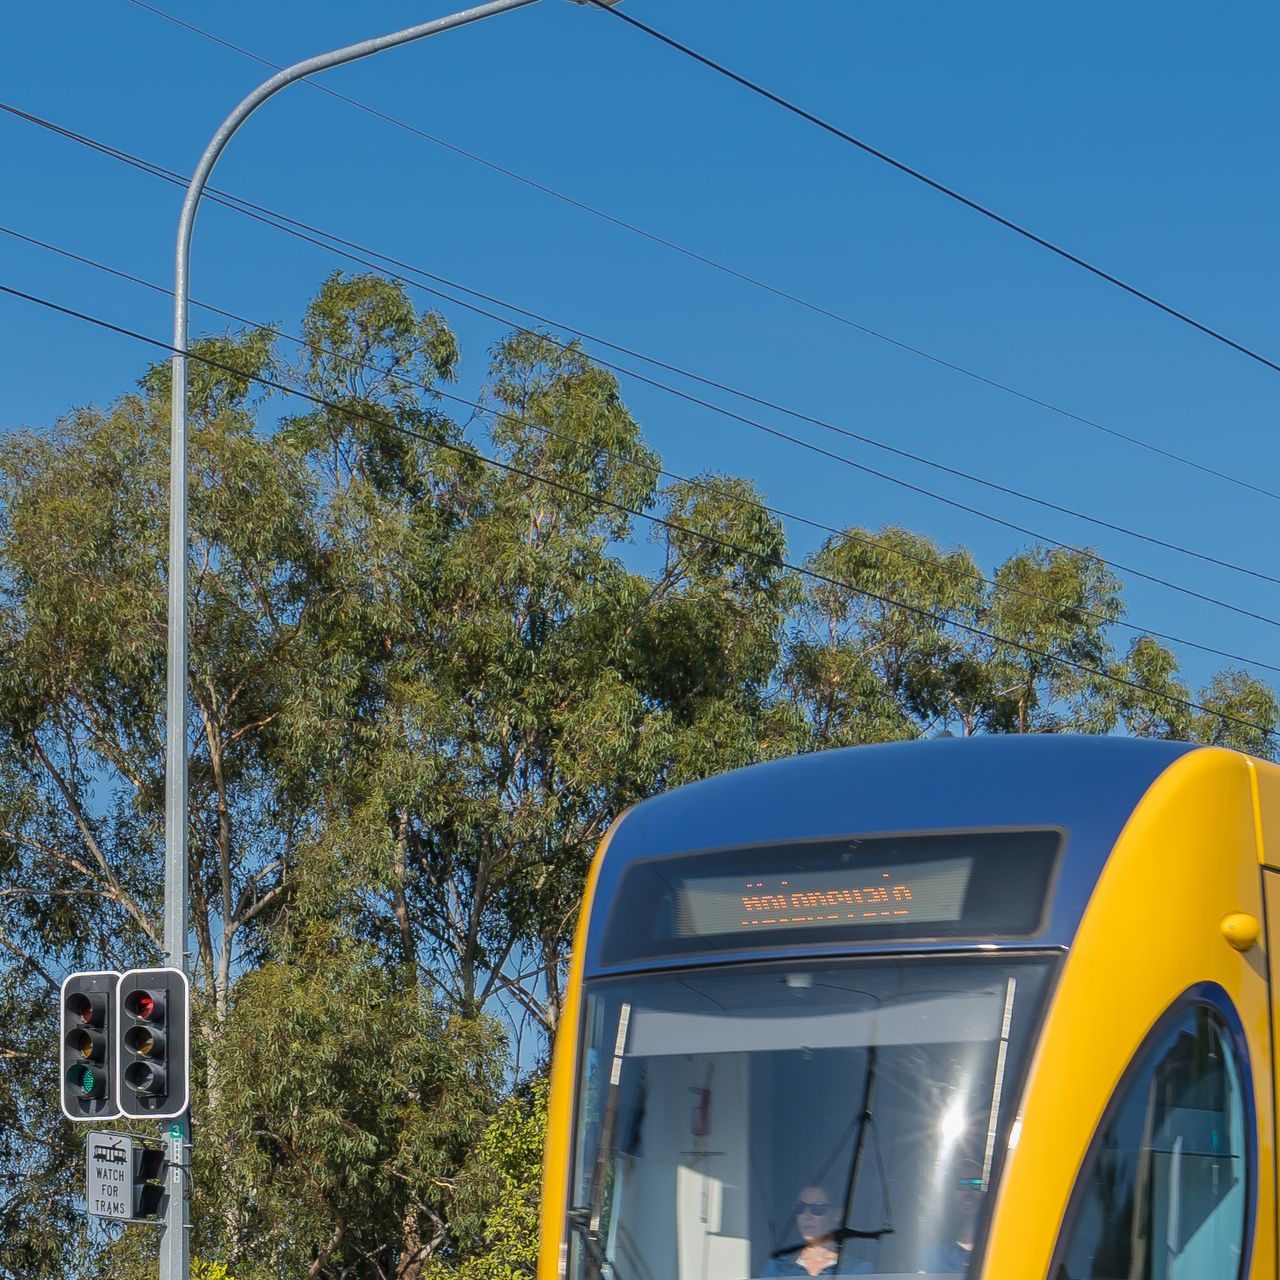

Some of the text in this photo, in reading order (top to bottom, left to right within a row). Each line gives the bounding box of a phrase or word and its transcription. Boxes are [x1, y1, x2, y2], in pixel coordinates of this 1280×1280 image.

[173, 1125, 180, 1136] 3
[96, 1167, 124, 1182] WATCH
[102, 1184, 118, 1197] FOR
[95, 1199, 125, 1215] TRAMS
